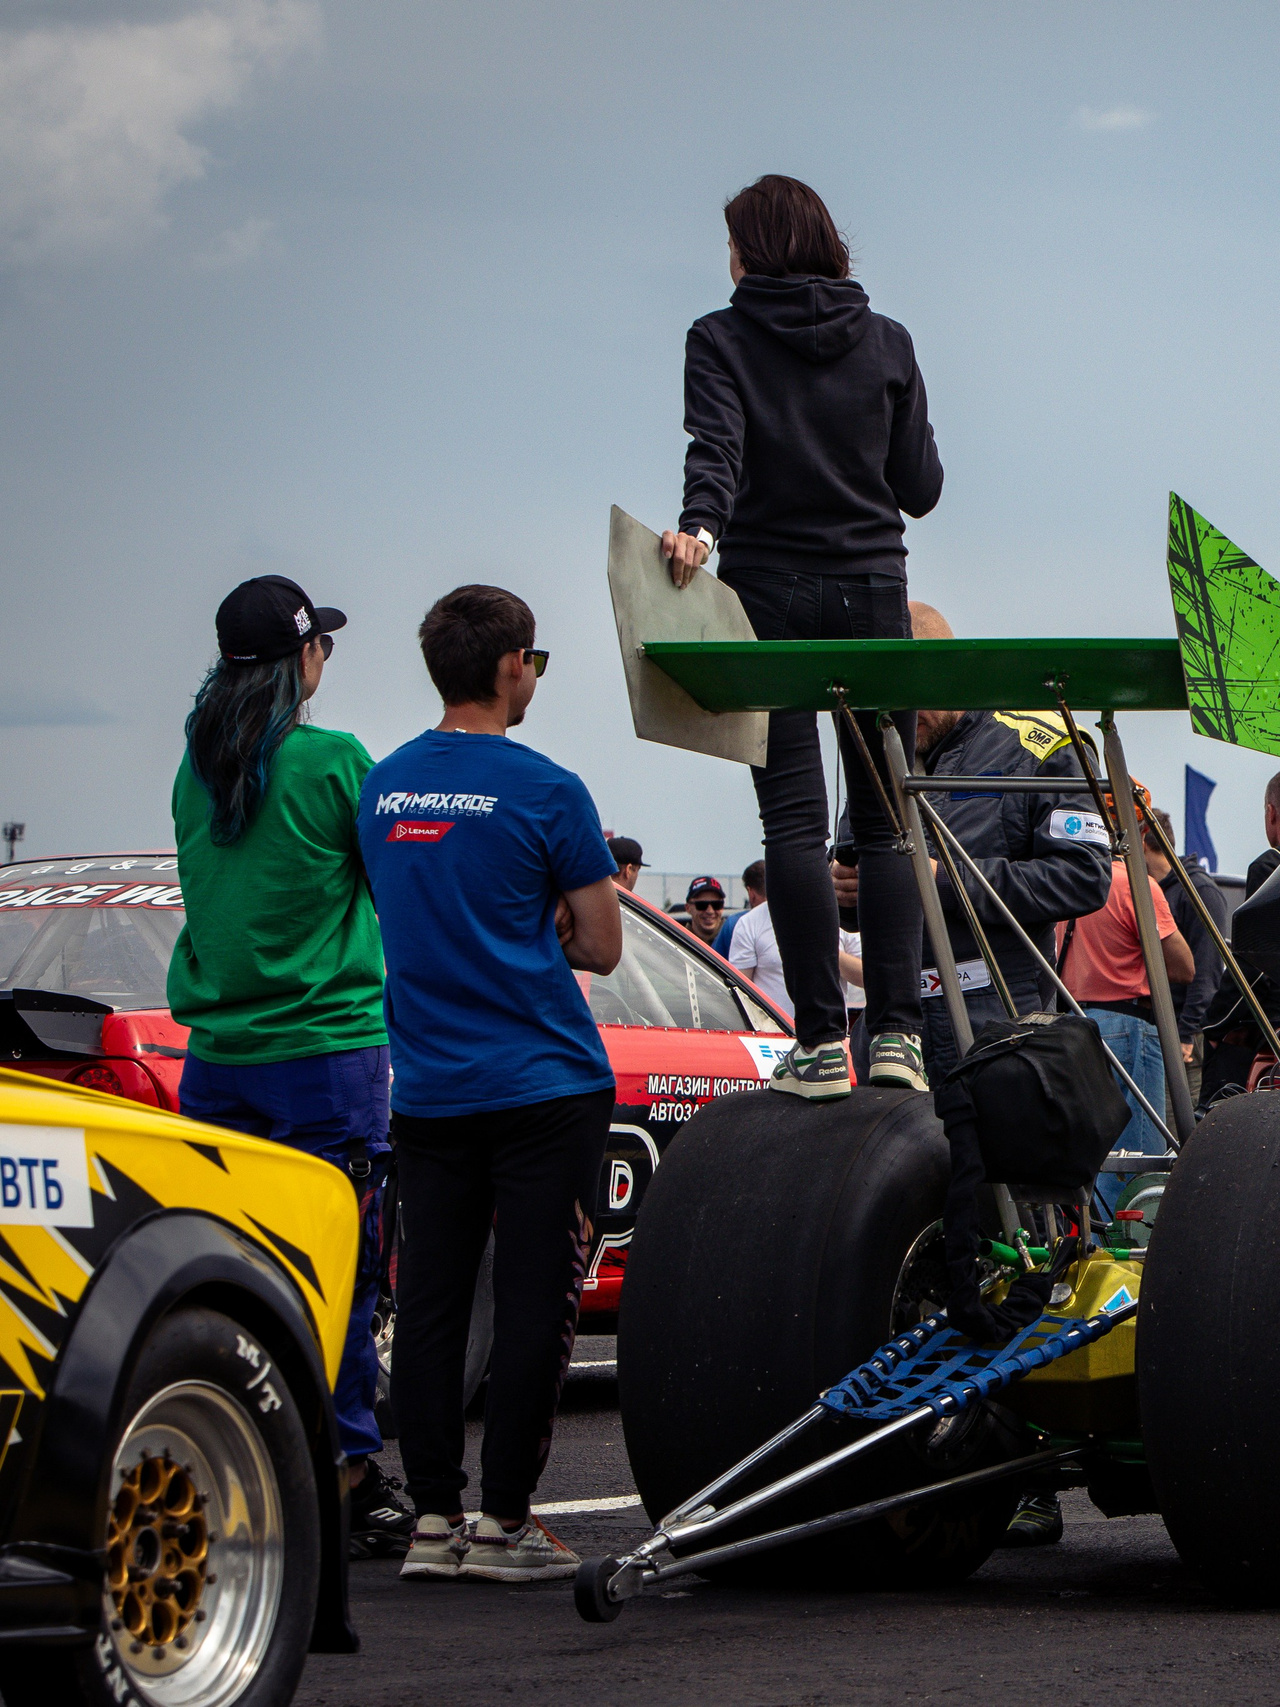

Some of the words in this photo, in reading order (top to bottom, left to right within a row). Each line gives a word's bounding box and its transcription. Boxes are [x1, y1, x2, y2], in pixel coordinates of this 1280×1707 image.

[1027, 730, 1052, 746] OMP
[407, 807, 491, 818] MOTORSPORT
[408, 827, 439, 835] LEMARC
[876, 1050, 905, 1060] Reebok
[818, 1066, 847, 1076] Reebok
[648, 1075, 710, 1097] МАГАЗИН
[0, 1157, 64, 1210] ВТБ
[236, 1334, 283, 1413] M/T
